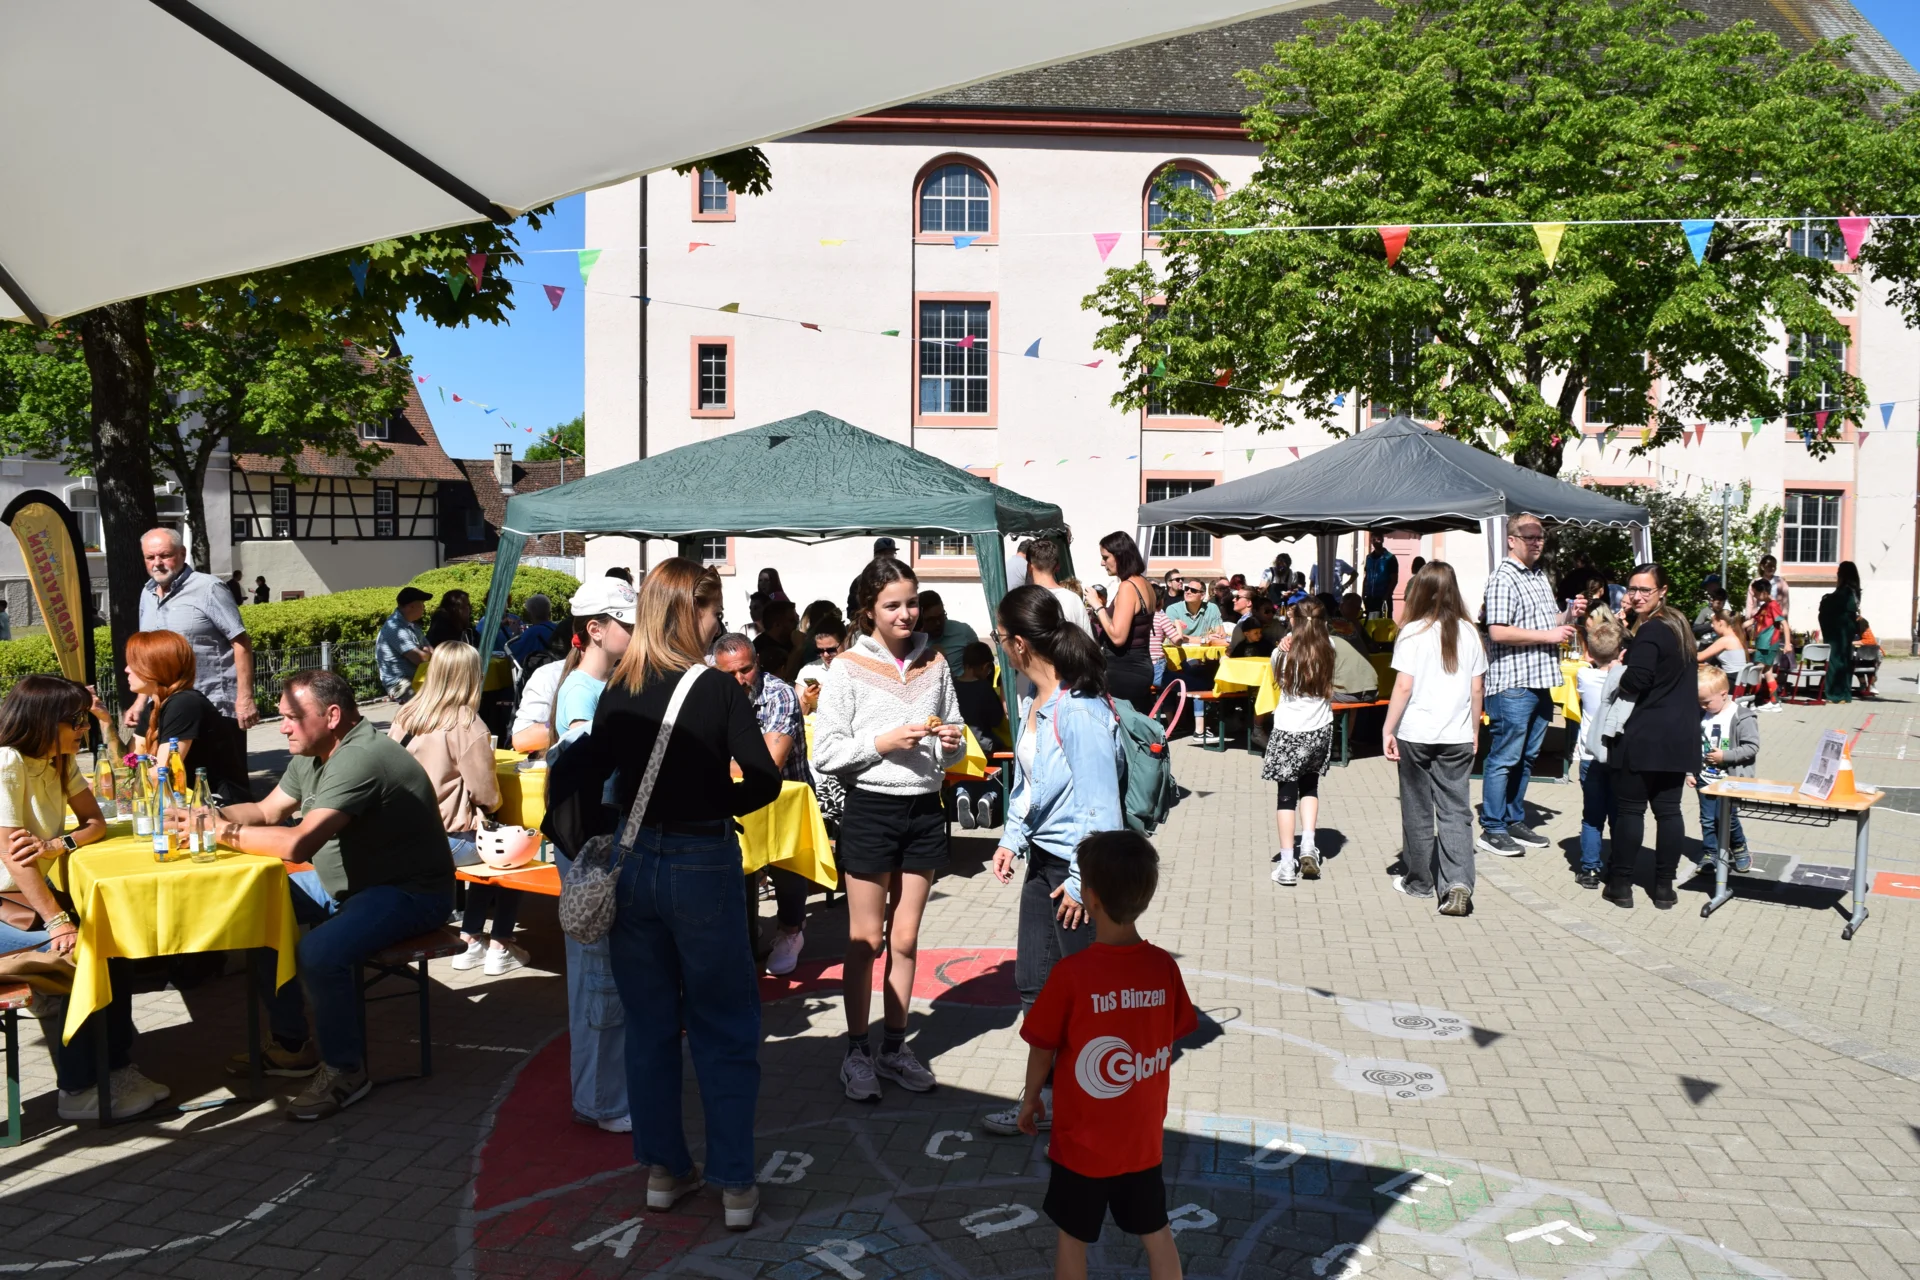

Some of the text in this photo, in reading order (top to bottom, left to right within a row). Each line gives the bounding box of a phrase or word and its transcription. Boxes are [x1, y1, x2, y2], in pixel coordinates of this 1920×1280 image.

[1091, 988, 1166, 1013] TuS Binzen
[1106, 1046, 1170, 1082] Glatt
[924, 1130, 973, 1161] C
[756, 1150, 814, 1184] B
[571, 1217, 645, 1258] A
[805, 1238, 866, 1280] P
